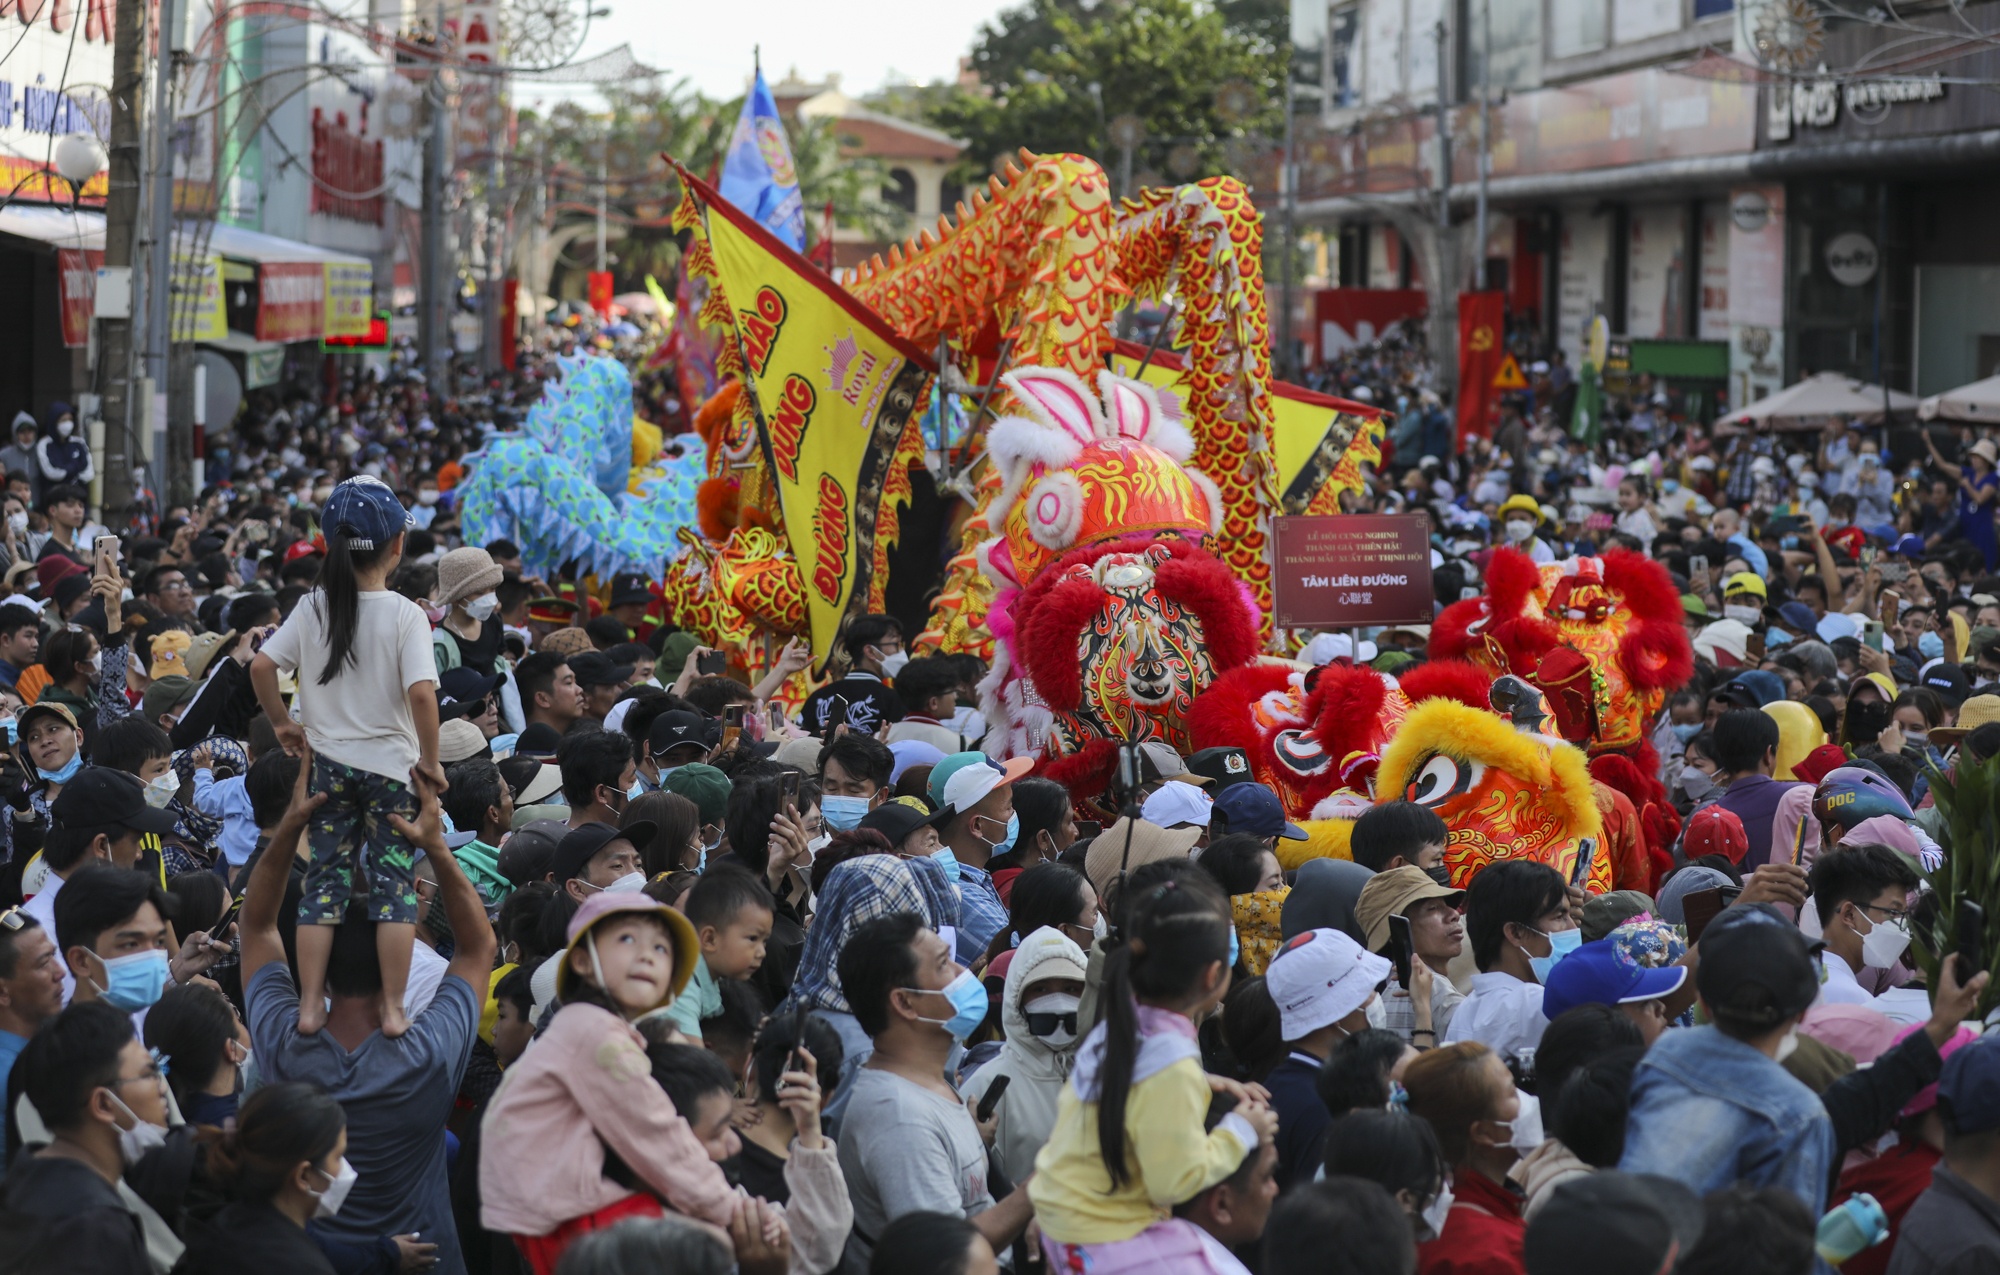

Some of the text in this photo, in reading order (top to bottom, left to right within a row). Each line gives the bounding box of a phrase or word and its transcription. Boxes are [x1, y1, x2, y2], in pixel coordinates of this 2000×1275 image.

[843, 349, 878, 407] Royal
[812, 472, 848, 607] ĐƯỜNG
[1339, 532, 1363, 540] CUNG
[1365, 531, 1399, 540] NGHINH
[1356, 541, 1381, 551] THIÊN
[1383, 541, 1402, 552] HẬU
[1379, 553, 1405, 563] THỊNH
[1407, 552, 1423, 562] HỘI
[1302, 573, 1407, 587] TÂM LIÊN ĐƯỜNG
[1339, 592, 1372, 604] 心聯堂
